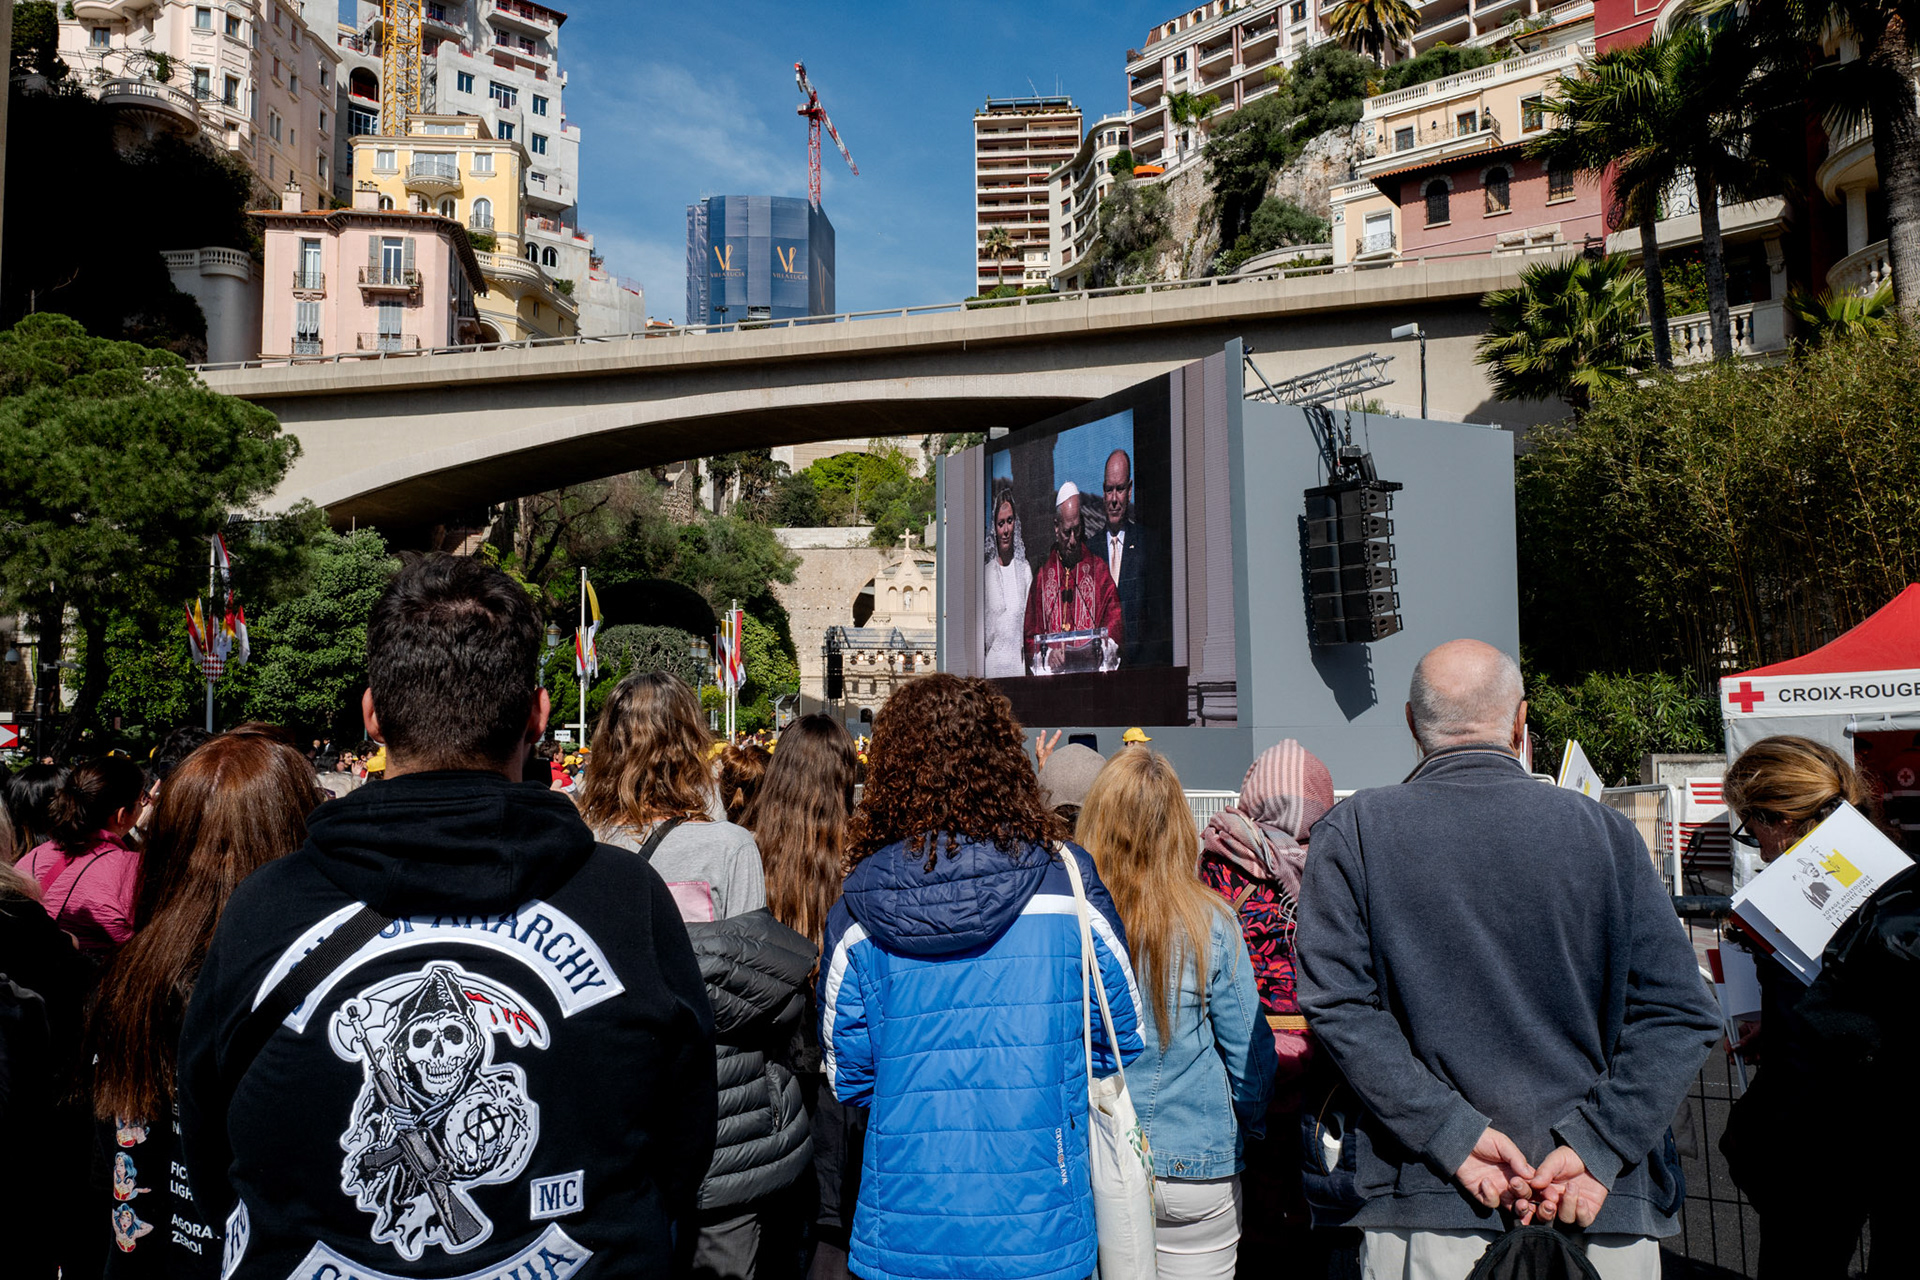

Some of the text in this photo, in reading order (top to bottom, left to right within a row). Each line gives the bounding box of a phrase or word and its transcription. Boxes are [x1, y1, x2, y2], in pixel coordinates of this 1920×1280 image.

[1822, 875, 1871, 918] VOYAGE APOSTOLIQUE
[539, 1180, 577, 1212] MC
[171, 1213, 213, 1240] AGORA
[171, 1230, 203, 1255] ZERO!
